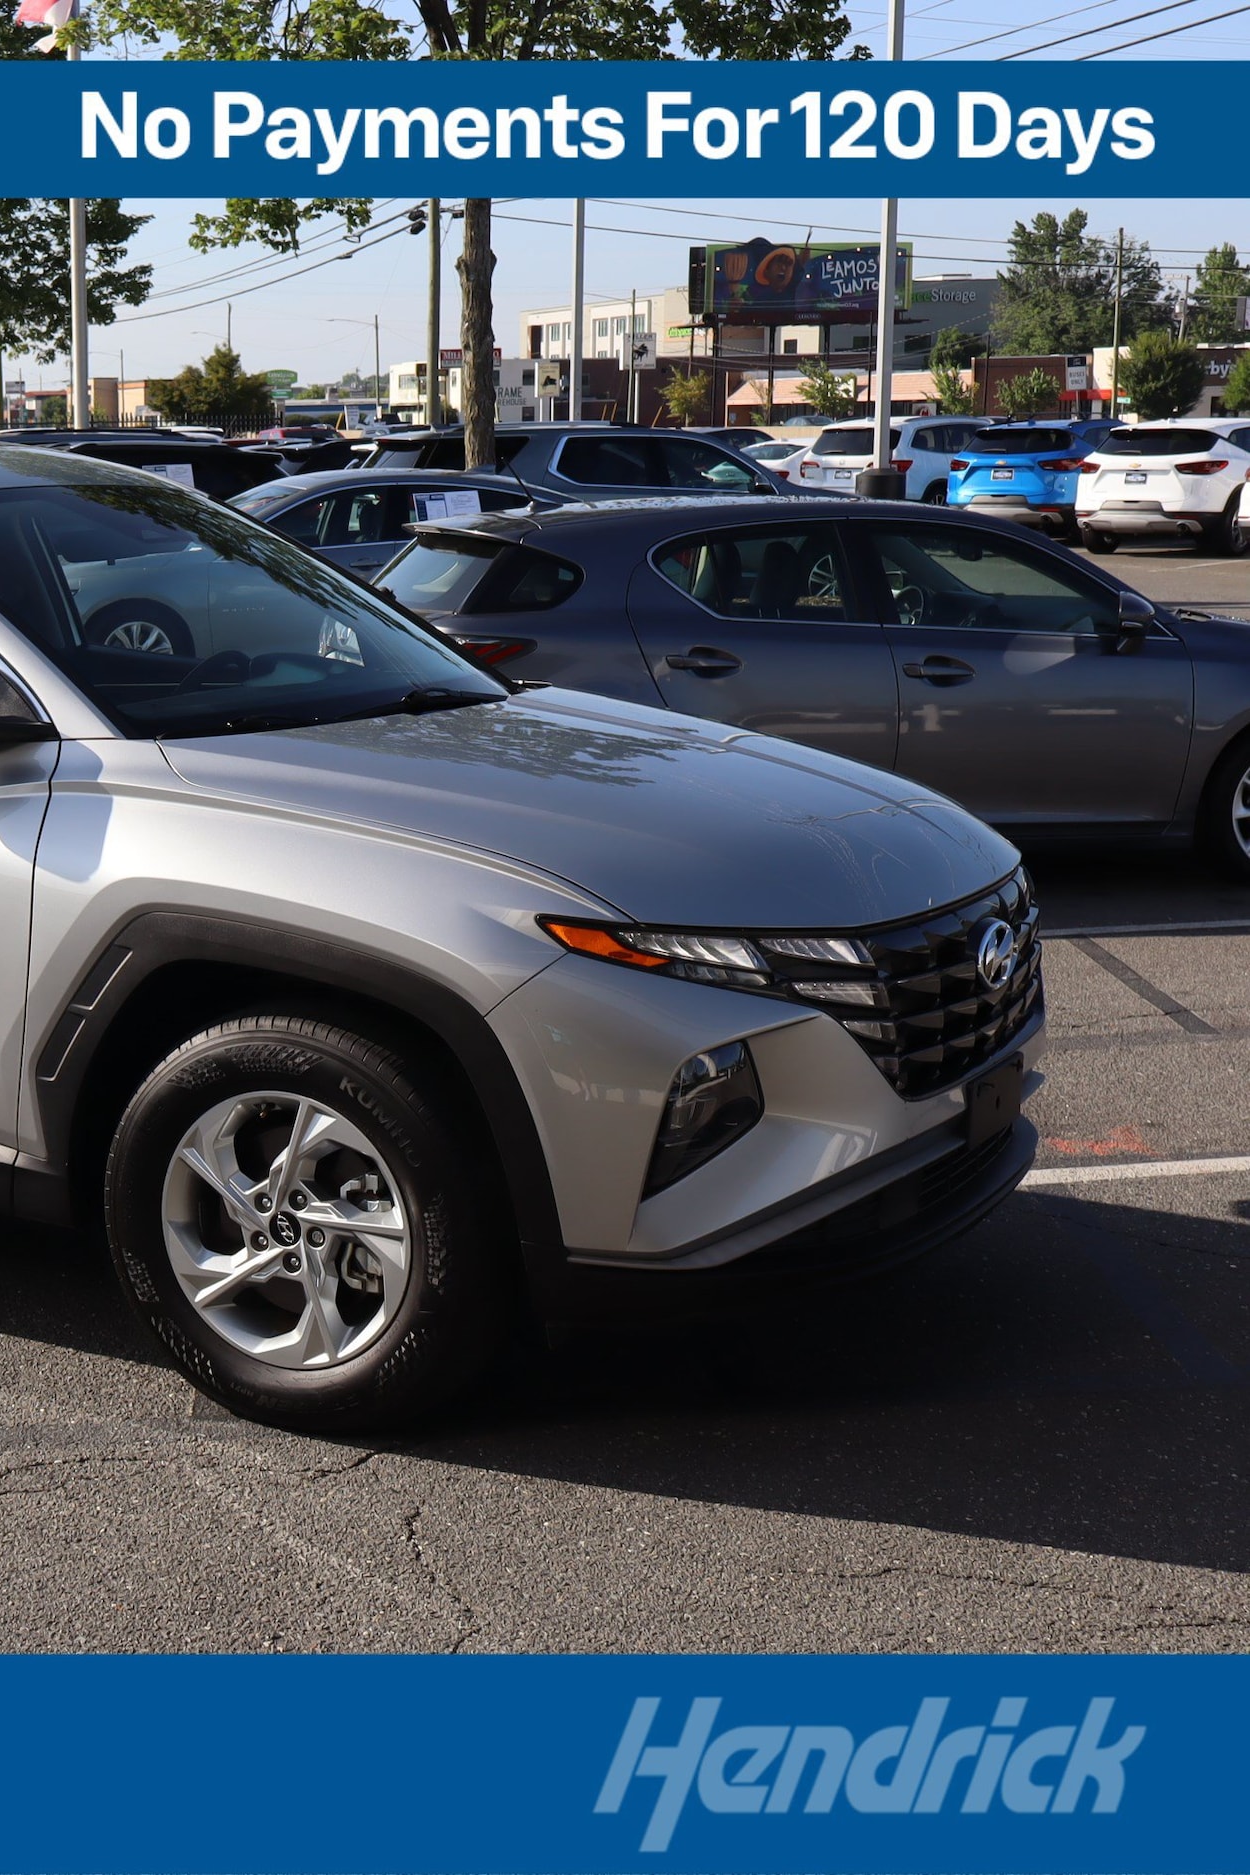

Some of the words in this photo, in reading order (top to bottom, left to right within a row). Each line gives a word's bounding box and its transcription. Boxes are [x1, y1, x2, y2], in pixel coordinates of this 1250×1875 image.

[821, 259, 877, 280] LEAMOS
[830, 277, 880, 298] JUNTO
[931, 288, 976, 304] Storage
